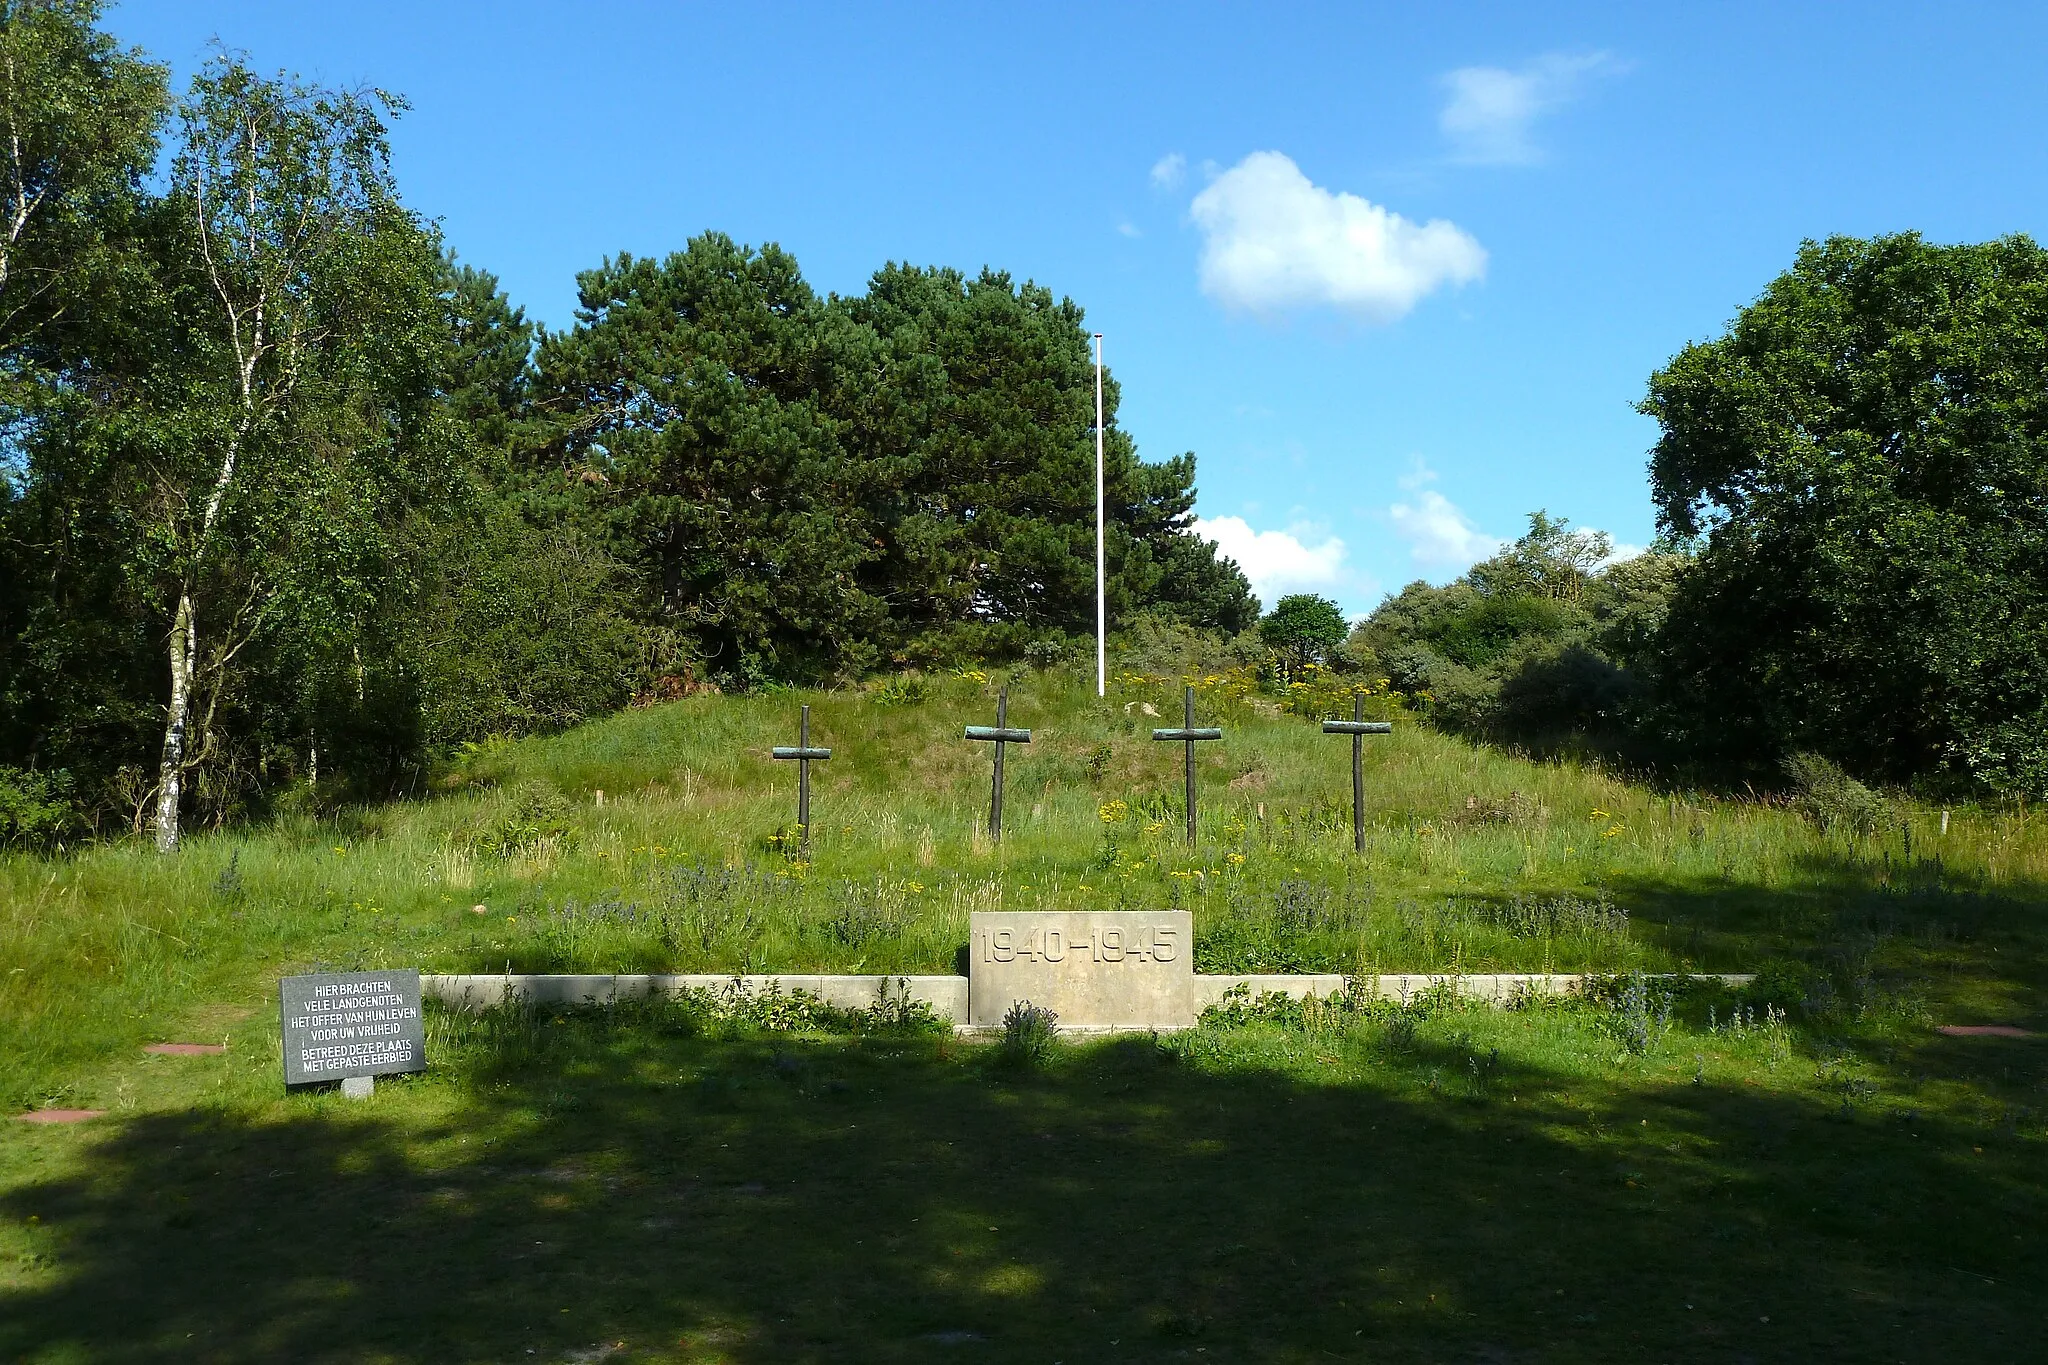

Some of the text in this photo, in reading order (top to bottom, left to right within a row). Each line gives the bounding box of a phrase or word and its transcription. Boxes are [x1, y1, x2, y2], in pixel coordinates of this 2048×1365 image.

[315, 981, 391, 997] HIER BRACHTEN
[304, 994, 403, 1012] VELE LANDGENOTEN
[291, 1007, 417, 1028] HET OFFER VAN HUN LEVEN
[311, 1022, 401, 1041] VOOR UW VRIJHEID
[302, 1039, 412, 1061] BETREED DEZE PLAATS
[303, 1050, 412, 1073] MET GEPASTE EERBIED
